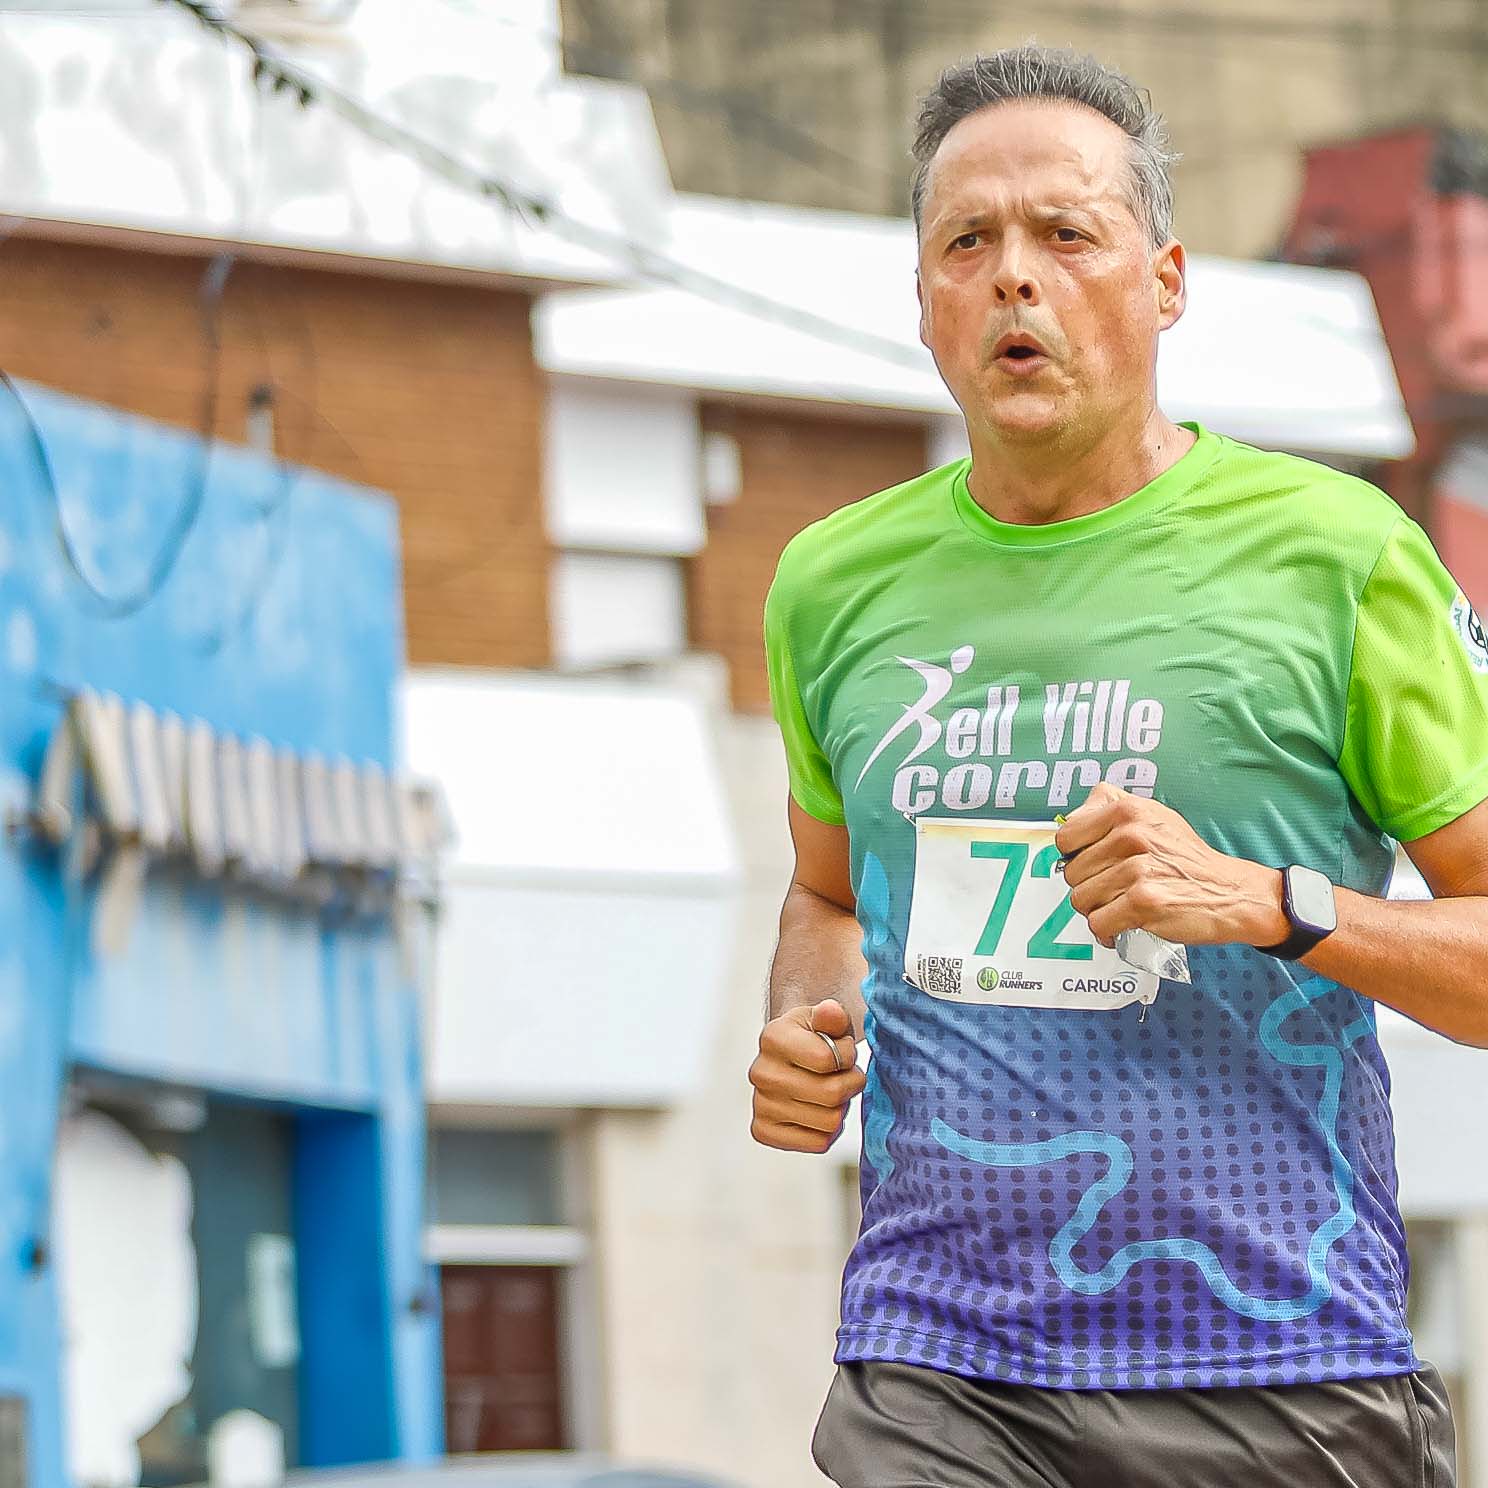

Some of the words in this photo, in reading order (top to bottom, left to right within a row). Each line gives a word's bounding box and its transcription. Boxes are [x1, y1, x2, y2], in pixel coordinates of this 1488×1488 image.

[1043, 679, 1164, 754] Ville
[892, 757, 1159, 815] corre
[970, 841, 1094, 961] 72
[1001, 970, 1023, 980] CLUB
[1062, 978, 1136, 994] CARUSO
